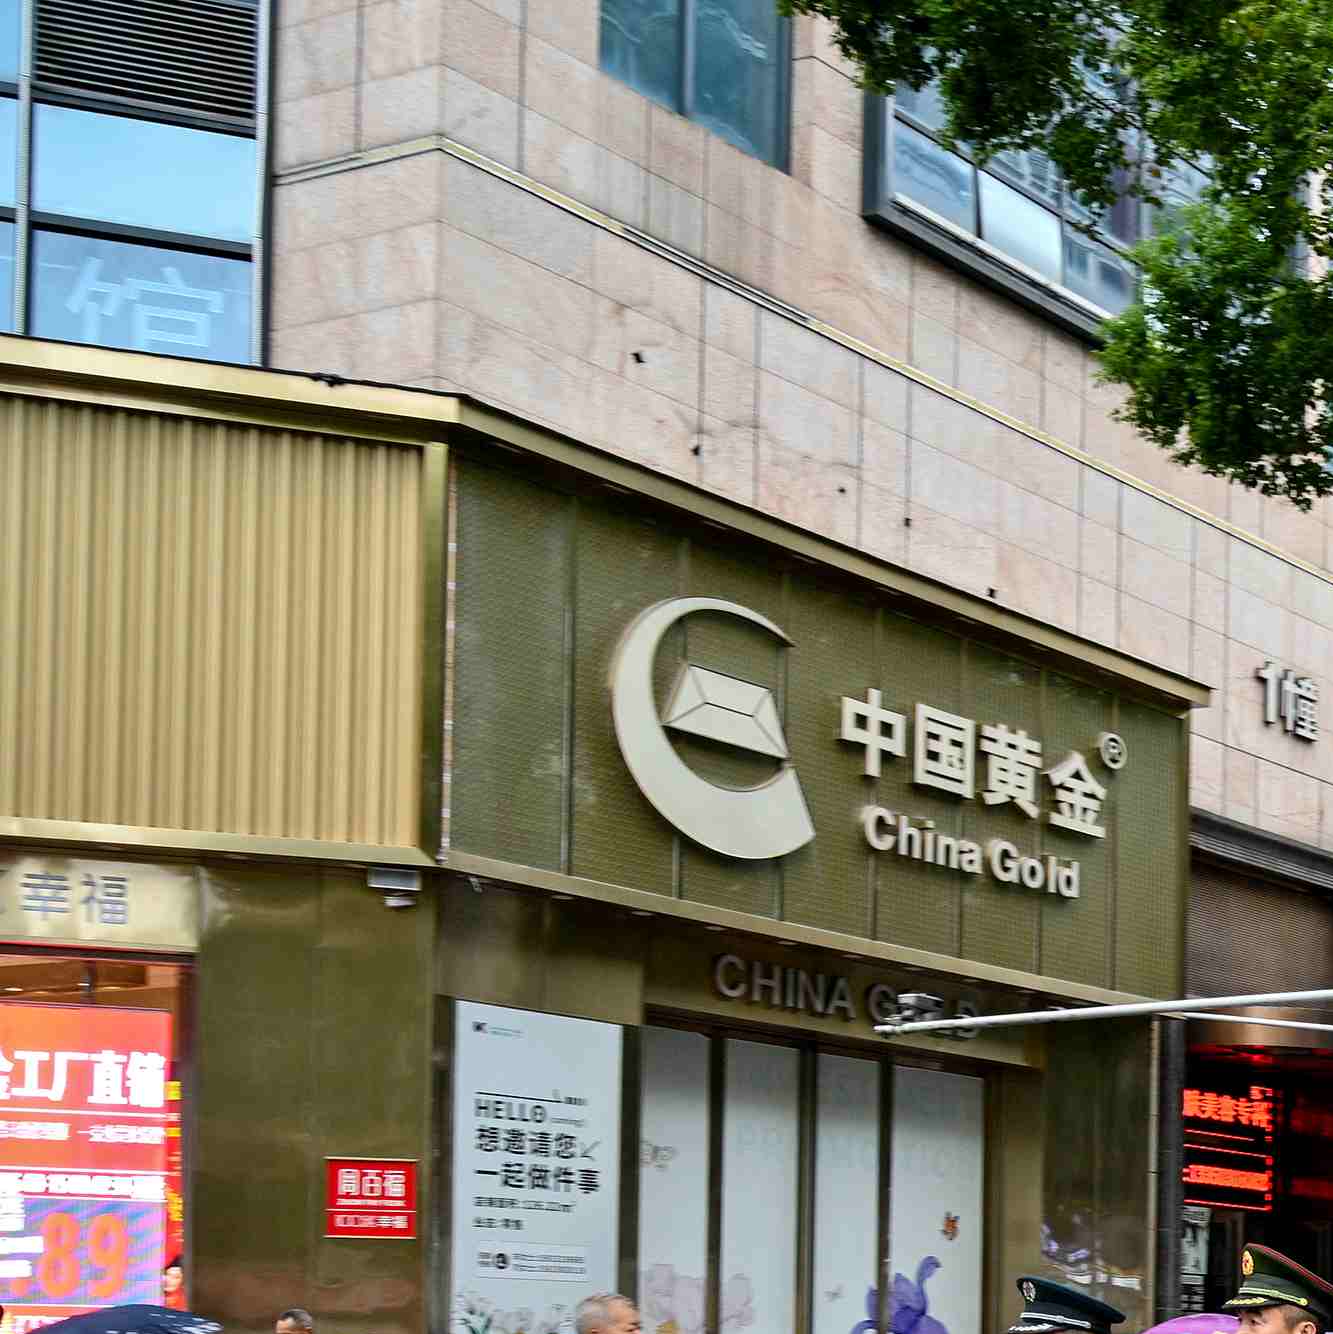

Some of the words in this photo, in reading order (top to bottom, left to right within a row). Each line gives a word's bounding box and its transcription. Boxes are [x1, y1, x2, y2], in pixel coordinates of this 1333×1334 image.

[839, 687, 1108, 839] 中国黄金
[864, 806, 983, 876] China
[990, 840, 1081, 899] Gold
[19, 868, 129, 925] 幸福
[715, 954, 856, 1020] CHINA
[474, 1098, 547, 1123] HELLO
[474, 1126, 577, 1160] 想邀请您
[337, 1168, 406, 1197] 周百福
[474, 1162, 601, 1195] 一起做件事
